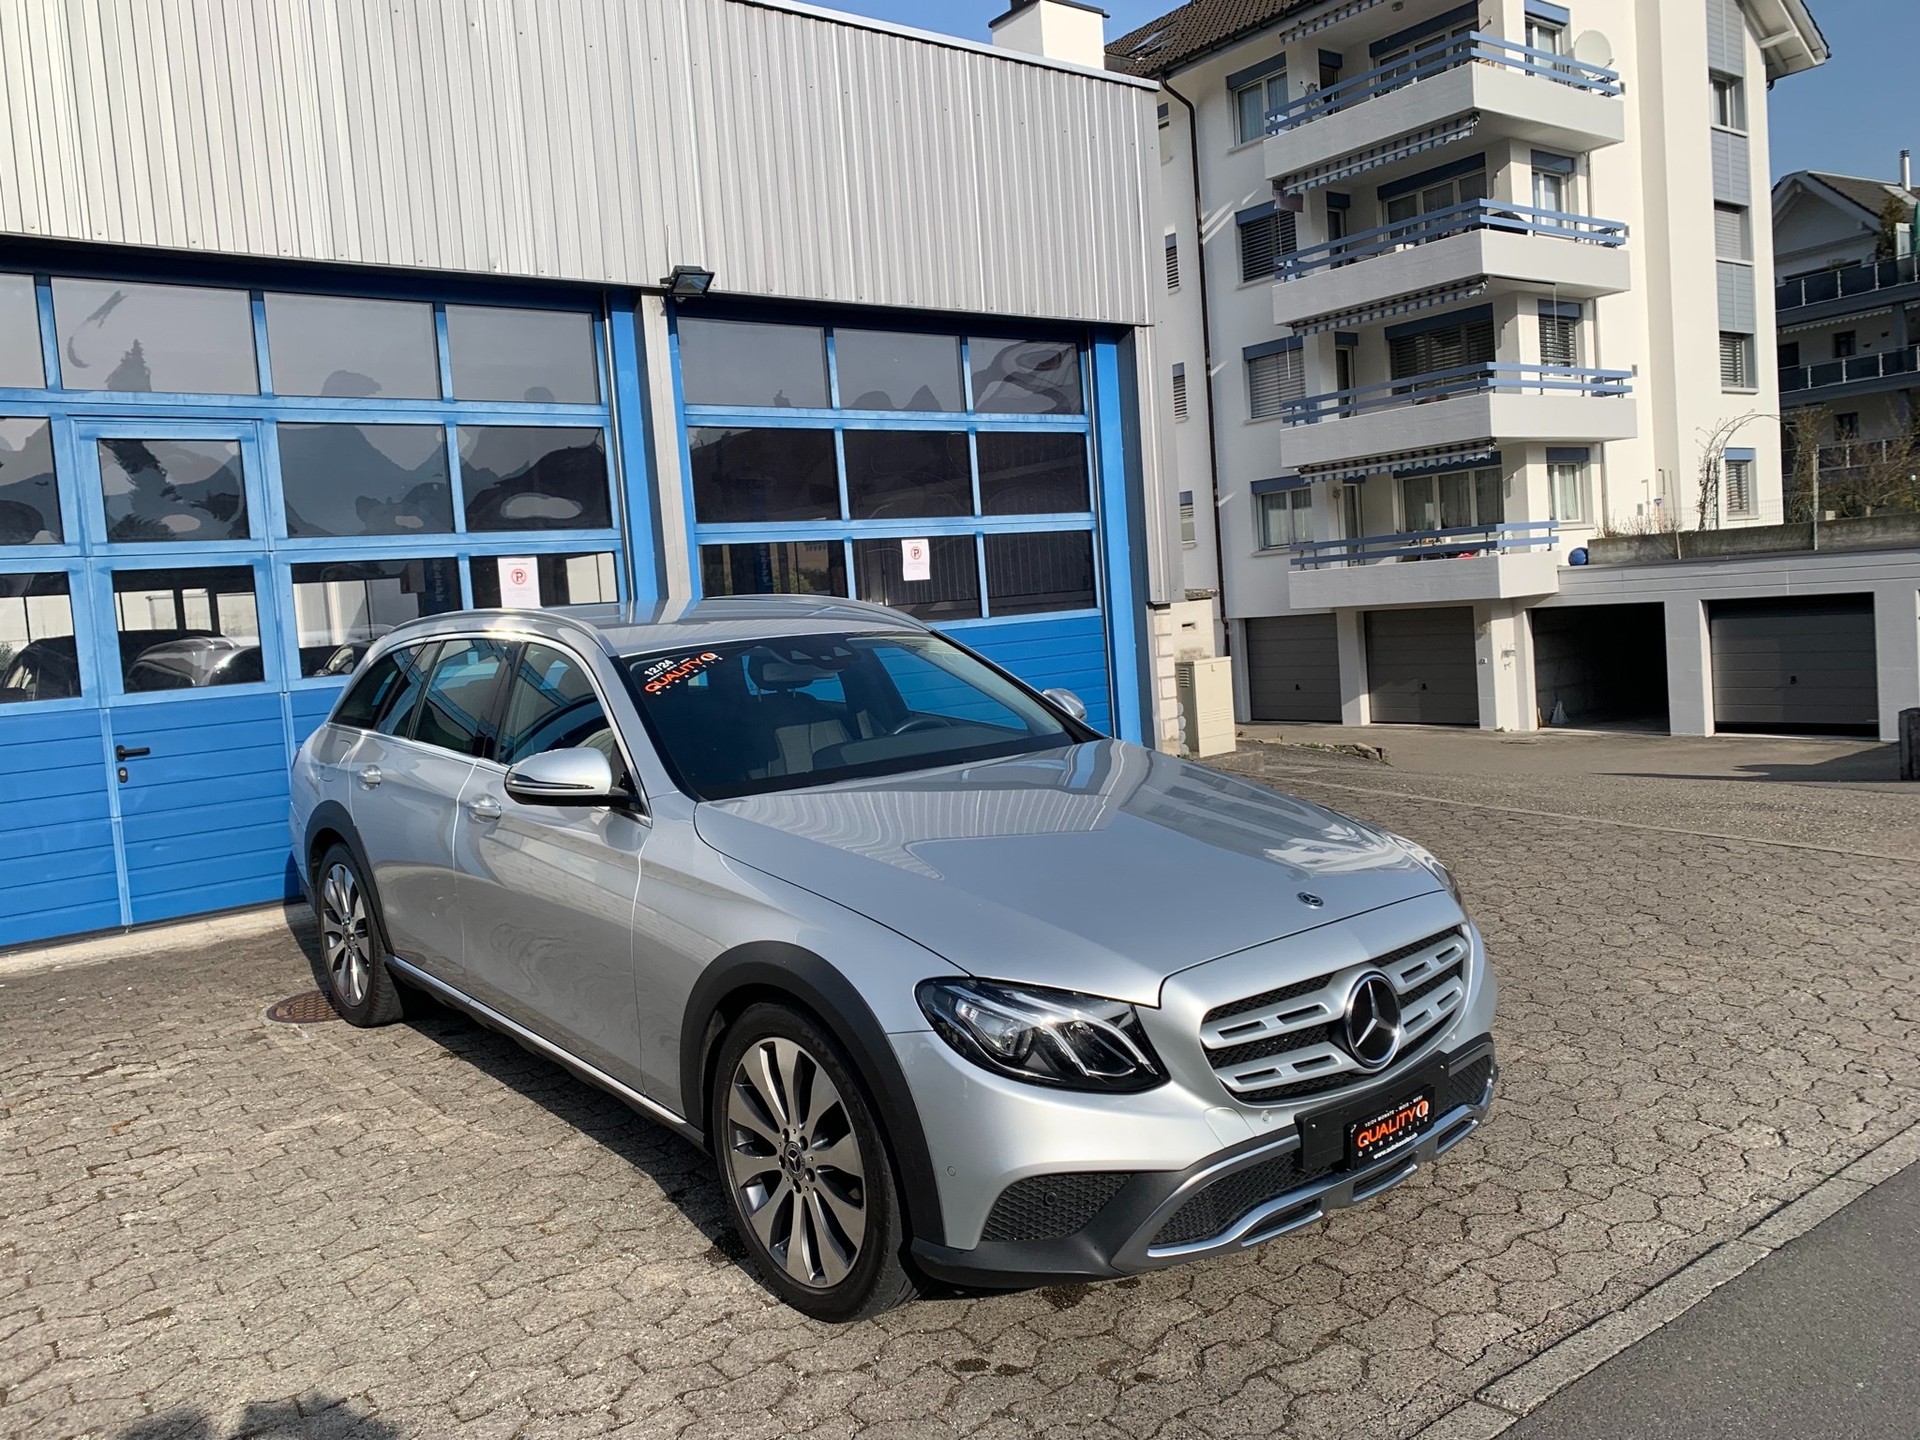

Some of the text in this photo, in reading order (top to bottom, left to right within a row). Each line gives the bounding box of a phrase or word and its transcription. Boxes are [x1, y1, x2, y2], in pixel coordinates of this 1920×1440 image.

[643, 659, 674, 676] 12/24
[645, 657, 703, 692] QUALITY
[1357, 1106, 1416, 1148] QUALITY
[1357, 1116, 1428, 1157] GARANTIE
